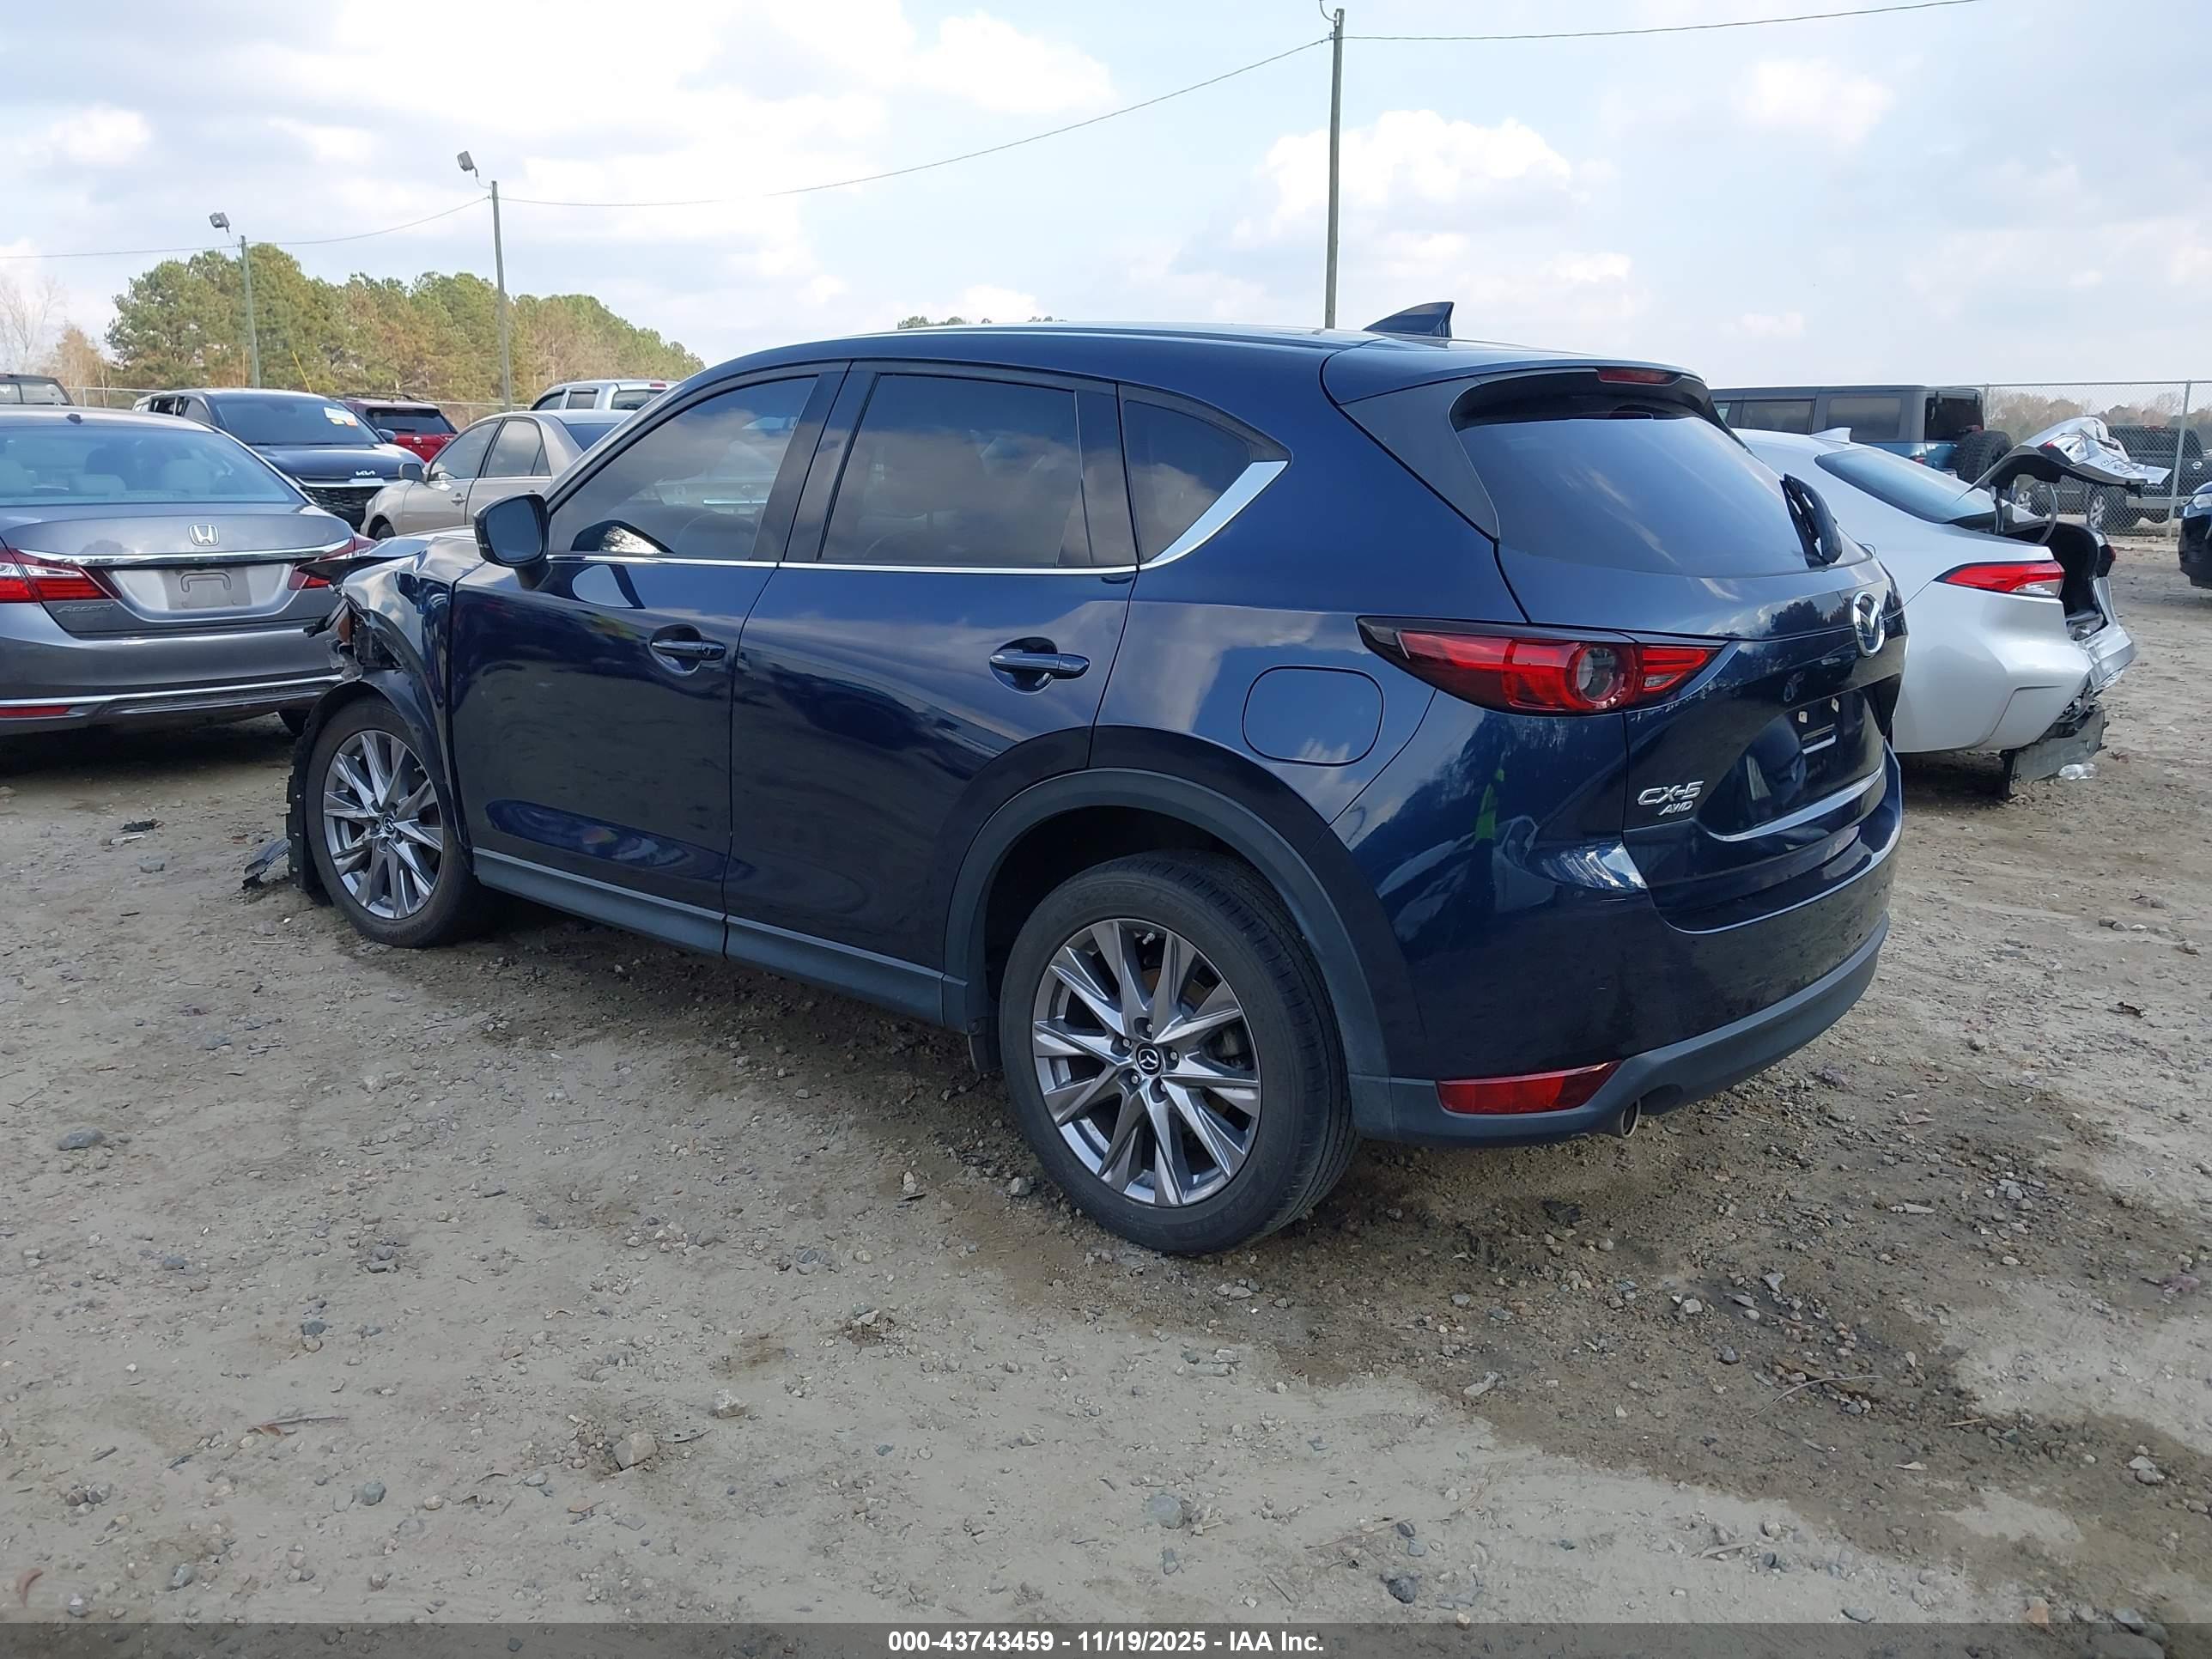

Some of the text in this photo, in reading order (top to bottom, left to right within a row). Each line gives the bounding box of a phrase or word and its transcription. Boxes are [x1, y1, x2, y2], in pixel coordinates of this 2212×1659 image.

[56, 603, 113, 613] Accord
[1637, 781, 1705, 805] CX-5
[1657, 800, 1693, 816] AWD
